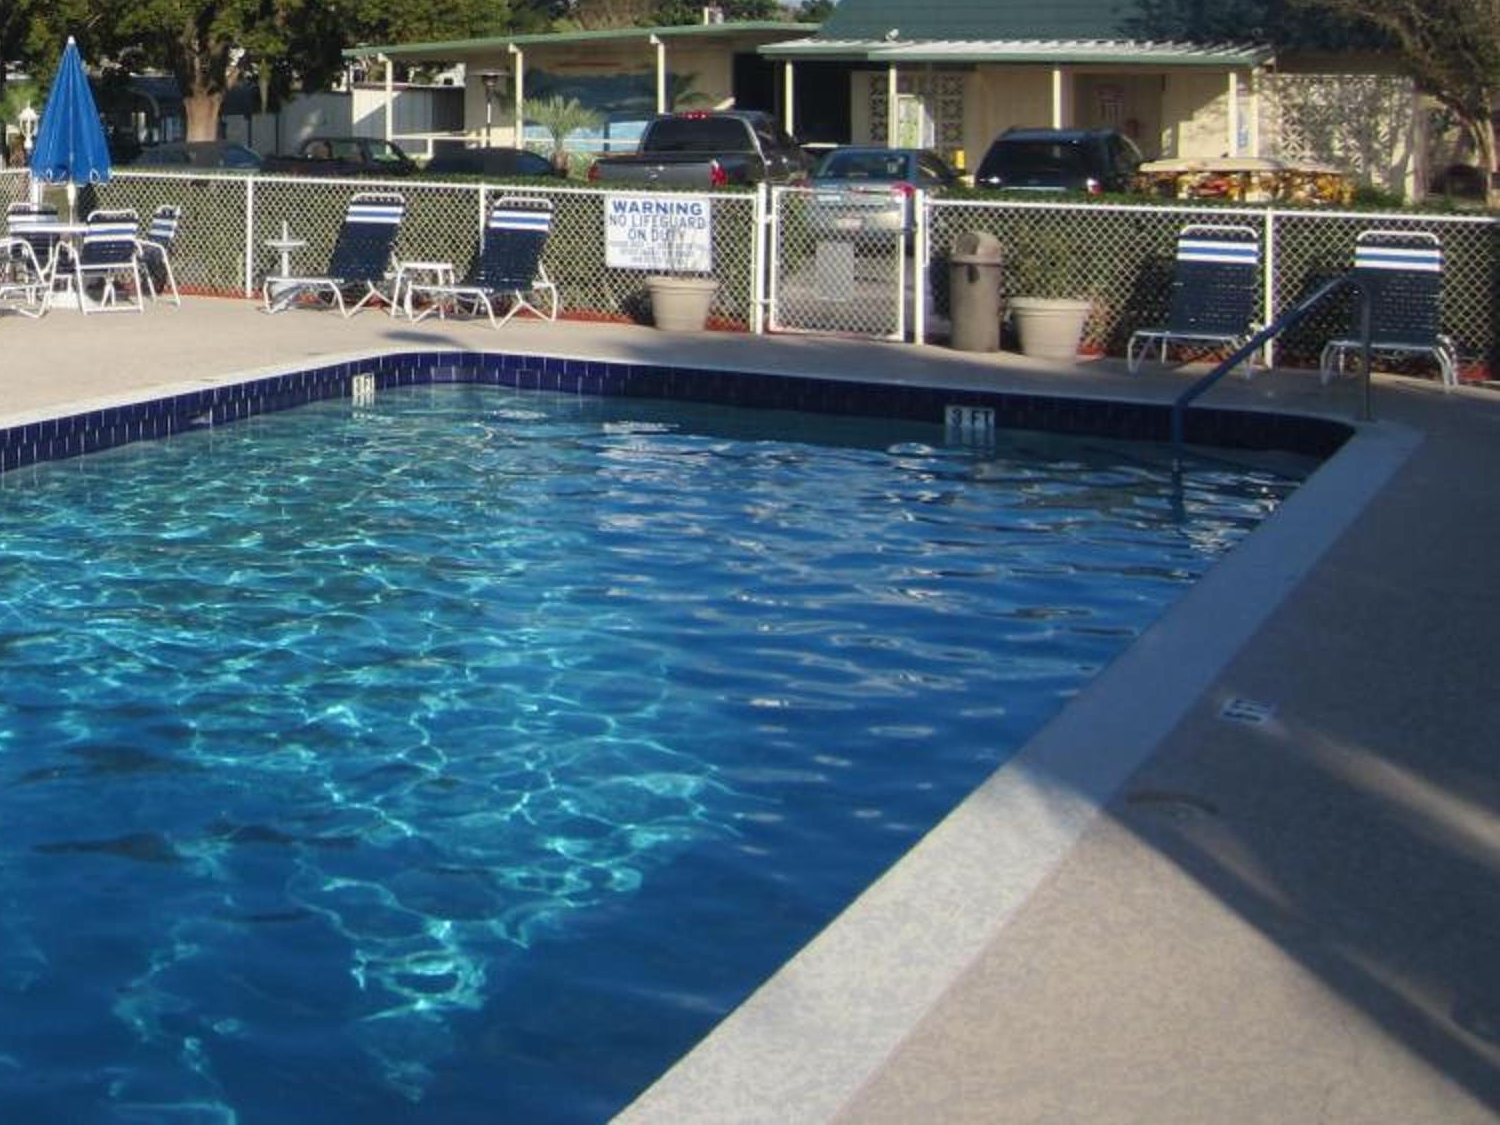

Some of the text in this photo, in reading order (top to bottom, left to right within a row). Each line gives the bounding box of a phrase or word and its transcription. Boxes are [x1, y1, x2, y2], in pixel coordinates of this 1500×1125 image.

[612, 200, 702, 216] WARNING
[609, 214, 706, 229] NO LIFEGUARD
[628, 227, 685, 242] ON DUTY
[971, 409, 993, 426] FT
